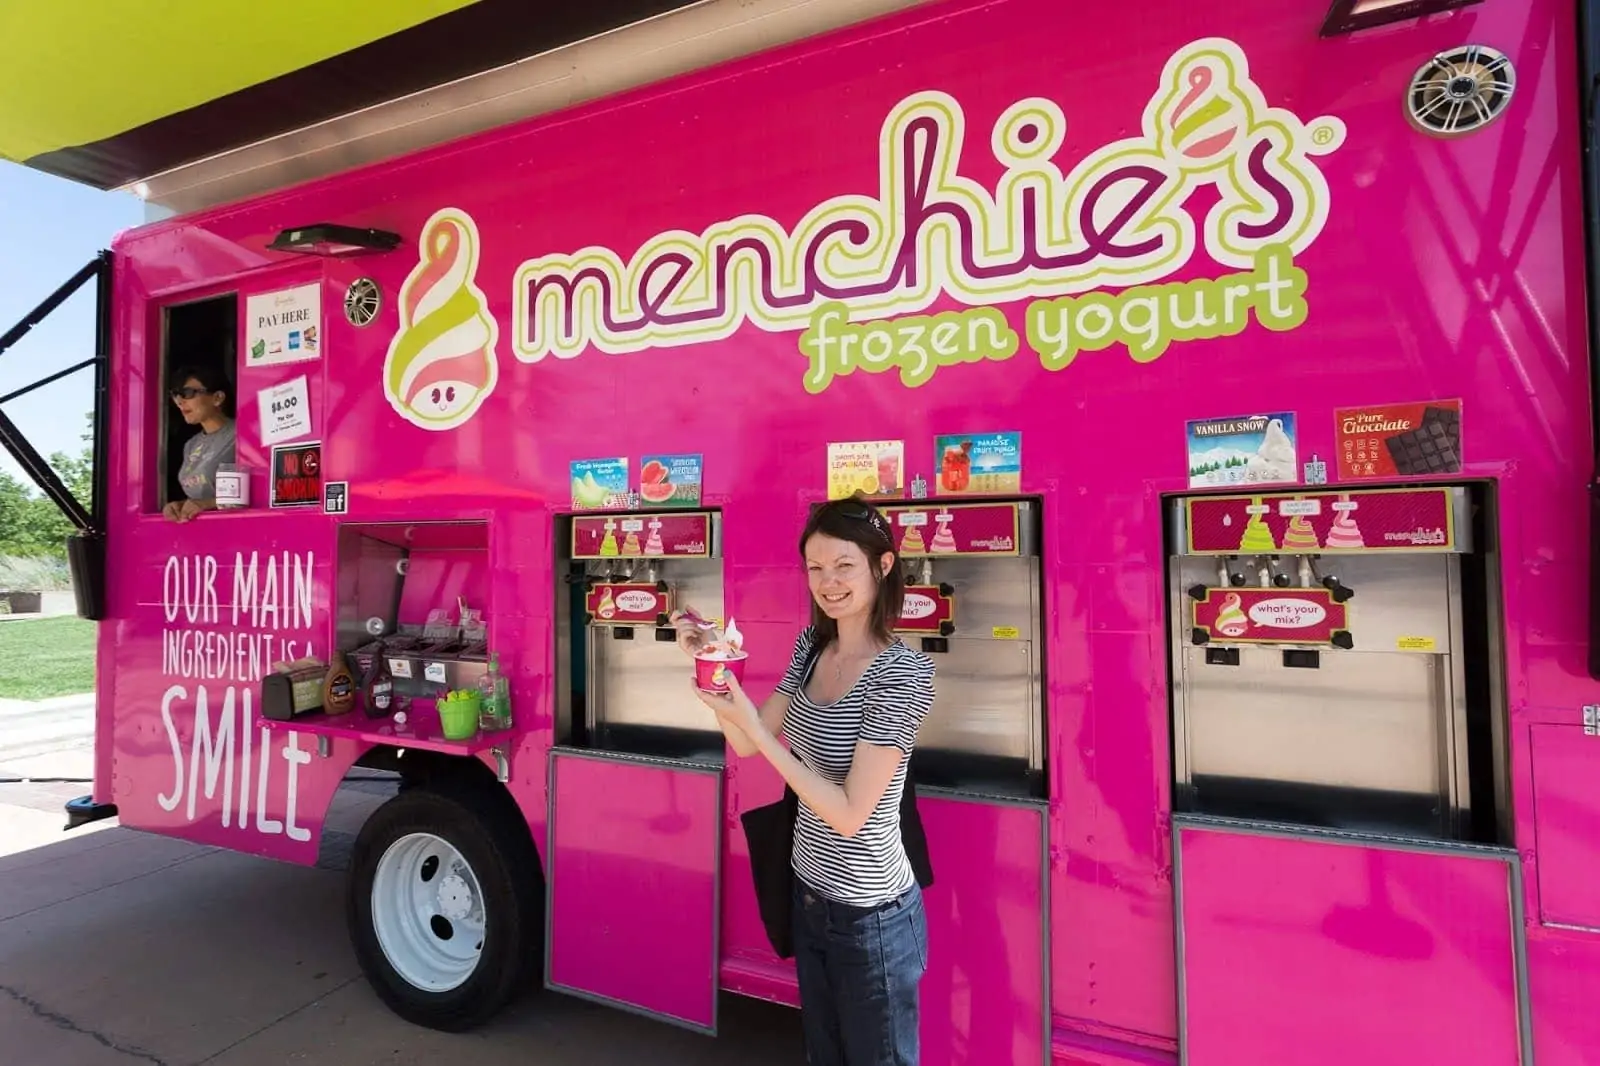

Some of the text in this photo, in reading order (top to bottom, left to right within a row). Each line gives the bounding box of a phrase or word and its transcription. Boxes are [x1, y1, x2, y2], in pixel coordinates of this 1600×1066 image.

[525, 68, 1297, 344] menchie's
[258, 308, 311, 329] PAY HERE
[809, 256, 1294, 385] frozen yogurt
[1343, 419, 1410, 434] Chocolate
[1356, 413, 1384, 423] Pure
[1195, 420, 1265, 435] VANILLA SNOW
[973, 444, 1016, 454] FRUIT PUNCH
[283, 453, 299, 475] NO
[163, 550, 313, 630] OUR MAIN
[914, 600, 931, 608] your
[1257, 604, 1318, 614] what's your
[1275, 616, 1301, 624] mix?
[162, 628, 274, 682] INGREDIENT
[157, 684, 312, 841] SMILE
